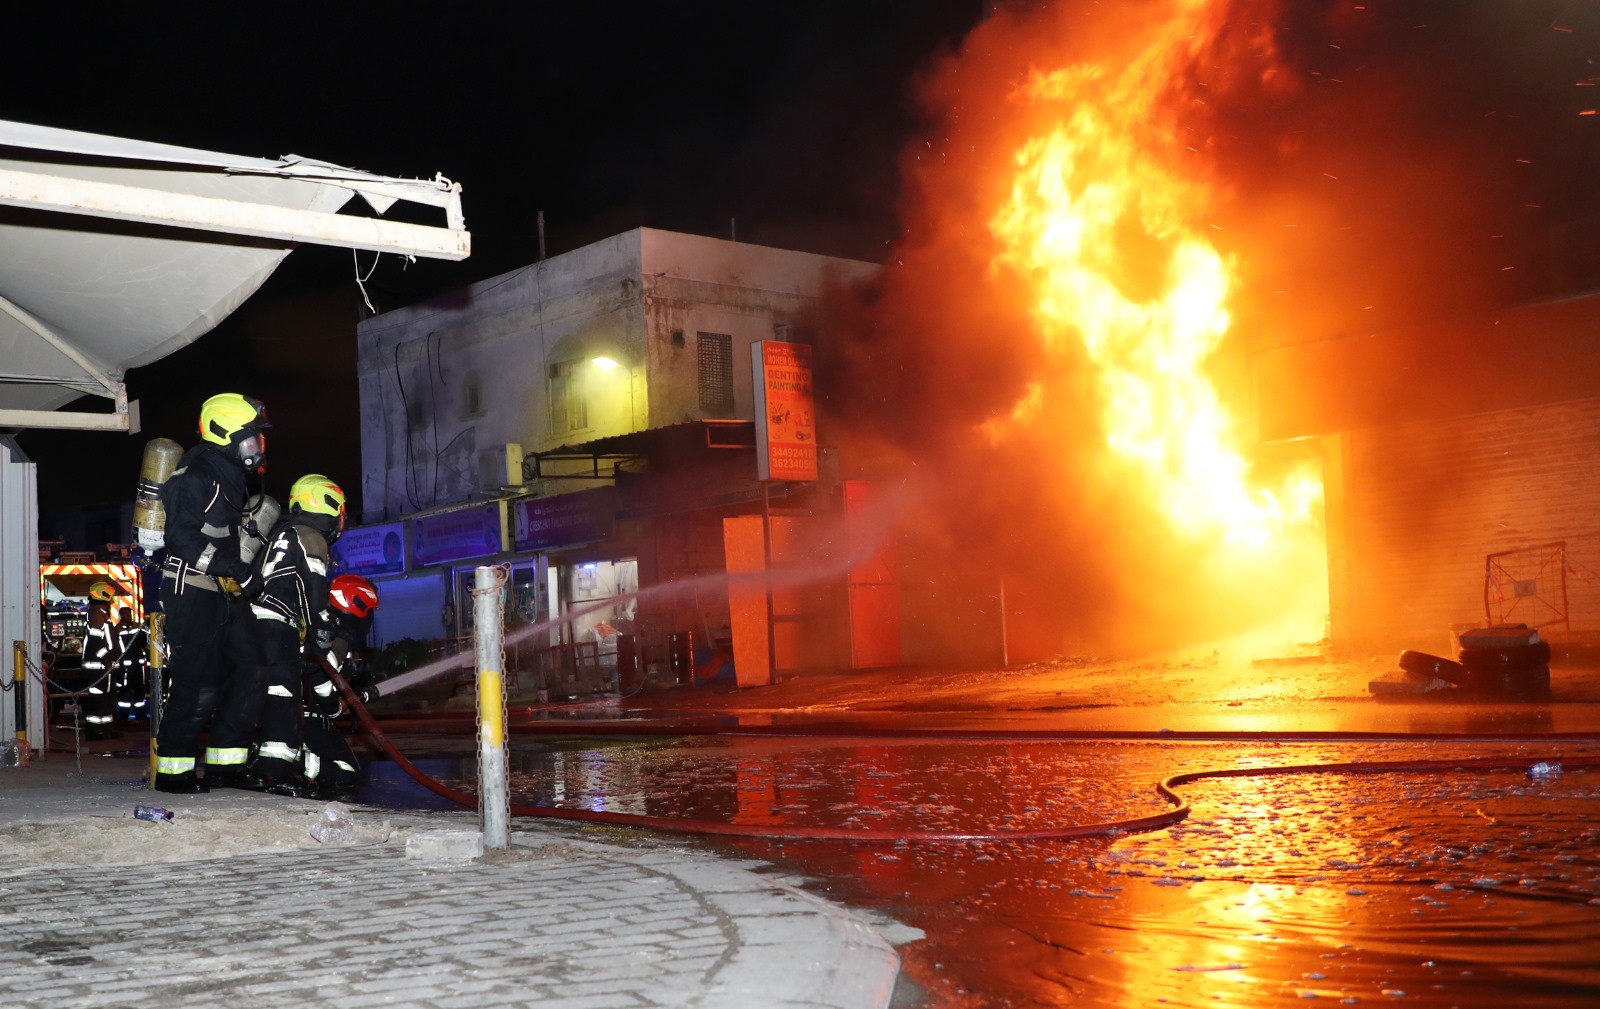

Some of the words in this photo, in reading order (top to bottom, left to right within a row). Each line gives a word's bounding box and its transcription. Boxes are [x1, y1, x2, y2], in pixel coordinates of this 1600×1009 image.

[768, 370, 809, 381] DENTING
[768, 381, 802, 392] PAINTING
[529, 518, 551, 532] CRESCENT
